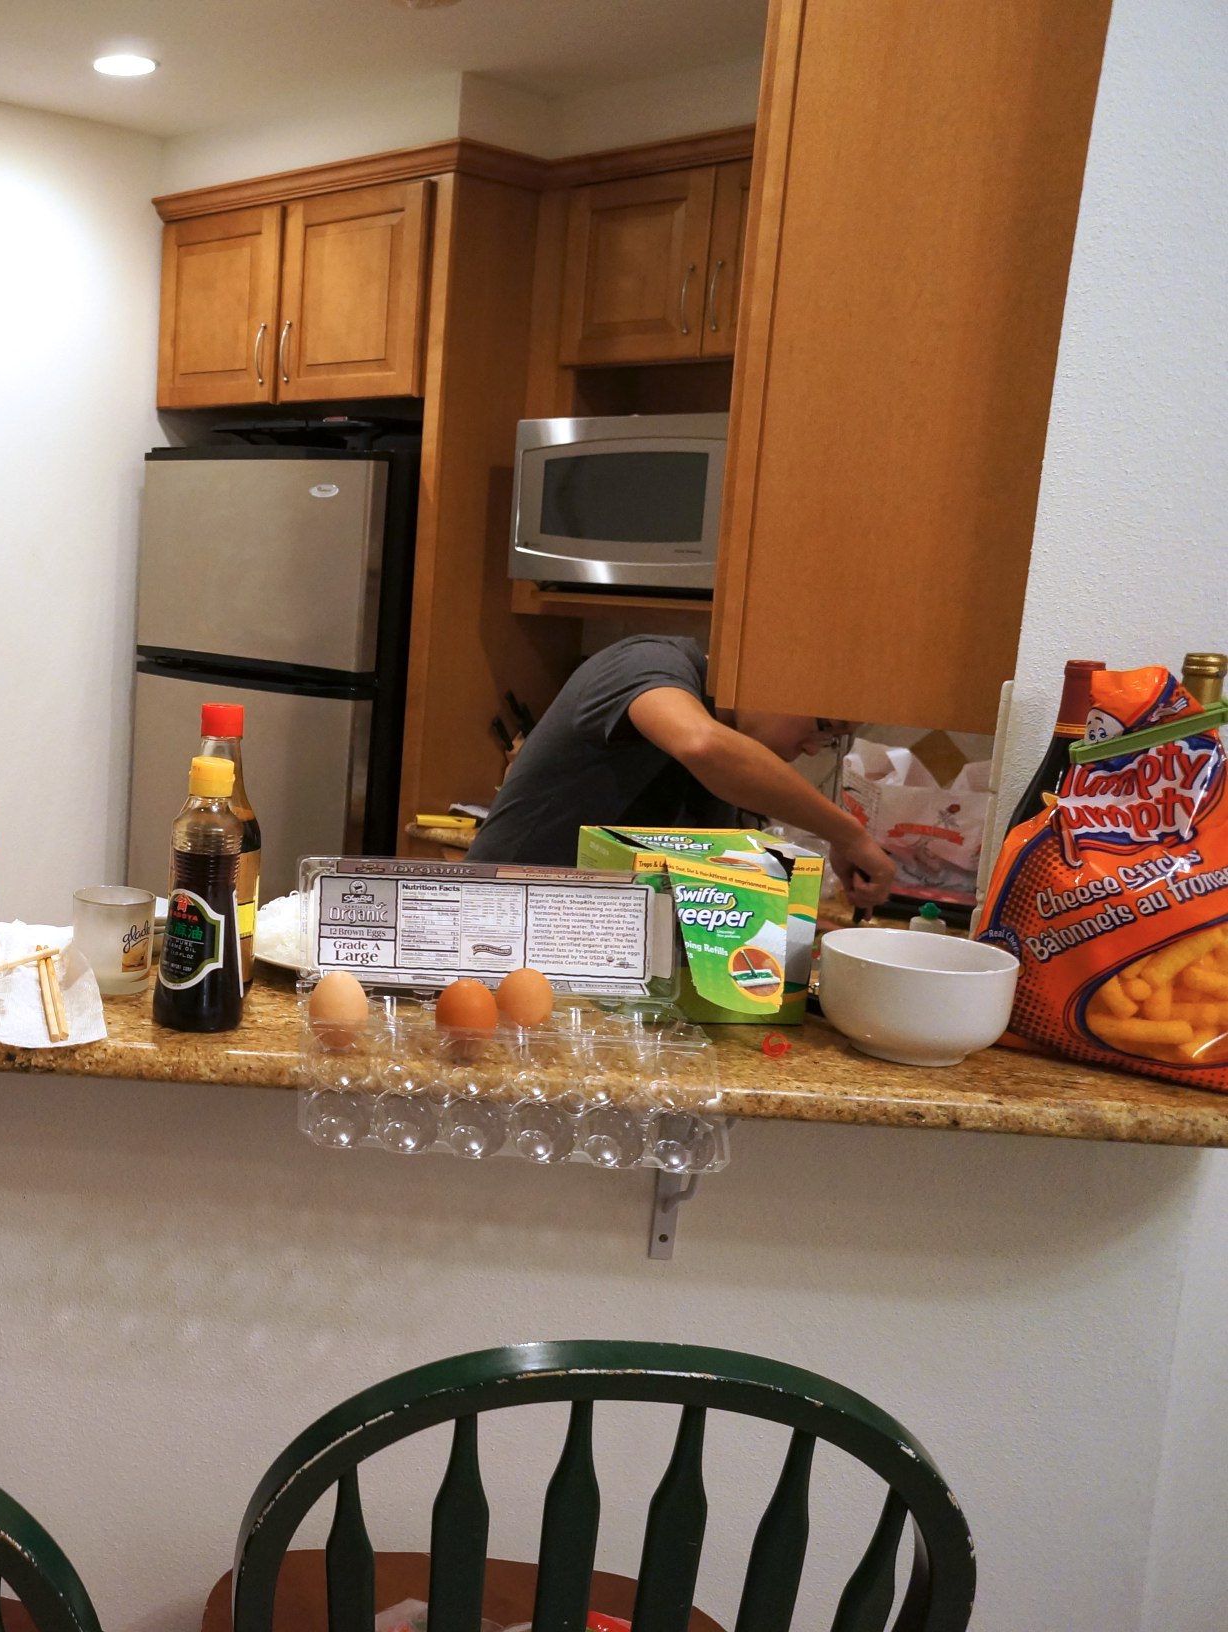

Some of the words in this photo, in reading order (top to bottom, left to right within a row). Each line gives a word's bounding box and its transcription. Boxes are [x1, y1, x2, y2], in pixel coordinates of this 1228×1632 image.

[1058, 787, 1206, 837] umpty
[644, 841, 714, 850] eeper
[638, 861, 653, 869] Traps
[675, 885, 734, 904] Swiffer
[1036, 876, 1122, 919] Cheese
[329, 904, 388, 924] Organic
[677, 908, 753, 931] eeper
[1025, 903, 1135, 961] Bâtonnets
[1138, 891, 1169, 915] au
[1166, 866, 1228, 901] froma
[338, 928, 364, 936] Brown
[366, 929, 386, 938] Eggs
[988, 929, 1005, 938] Real
[333, 940, 368, 951] Grade
[372, 942, 381, 950] A
[685, 941, 702, 952] ping
[704, 943, 728, 957] Refills
[335, 950, 378, 964] Large
